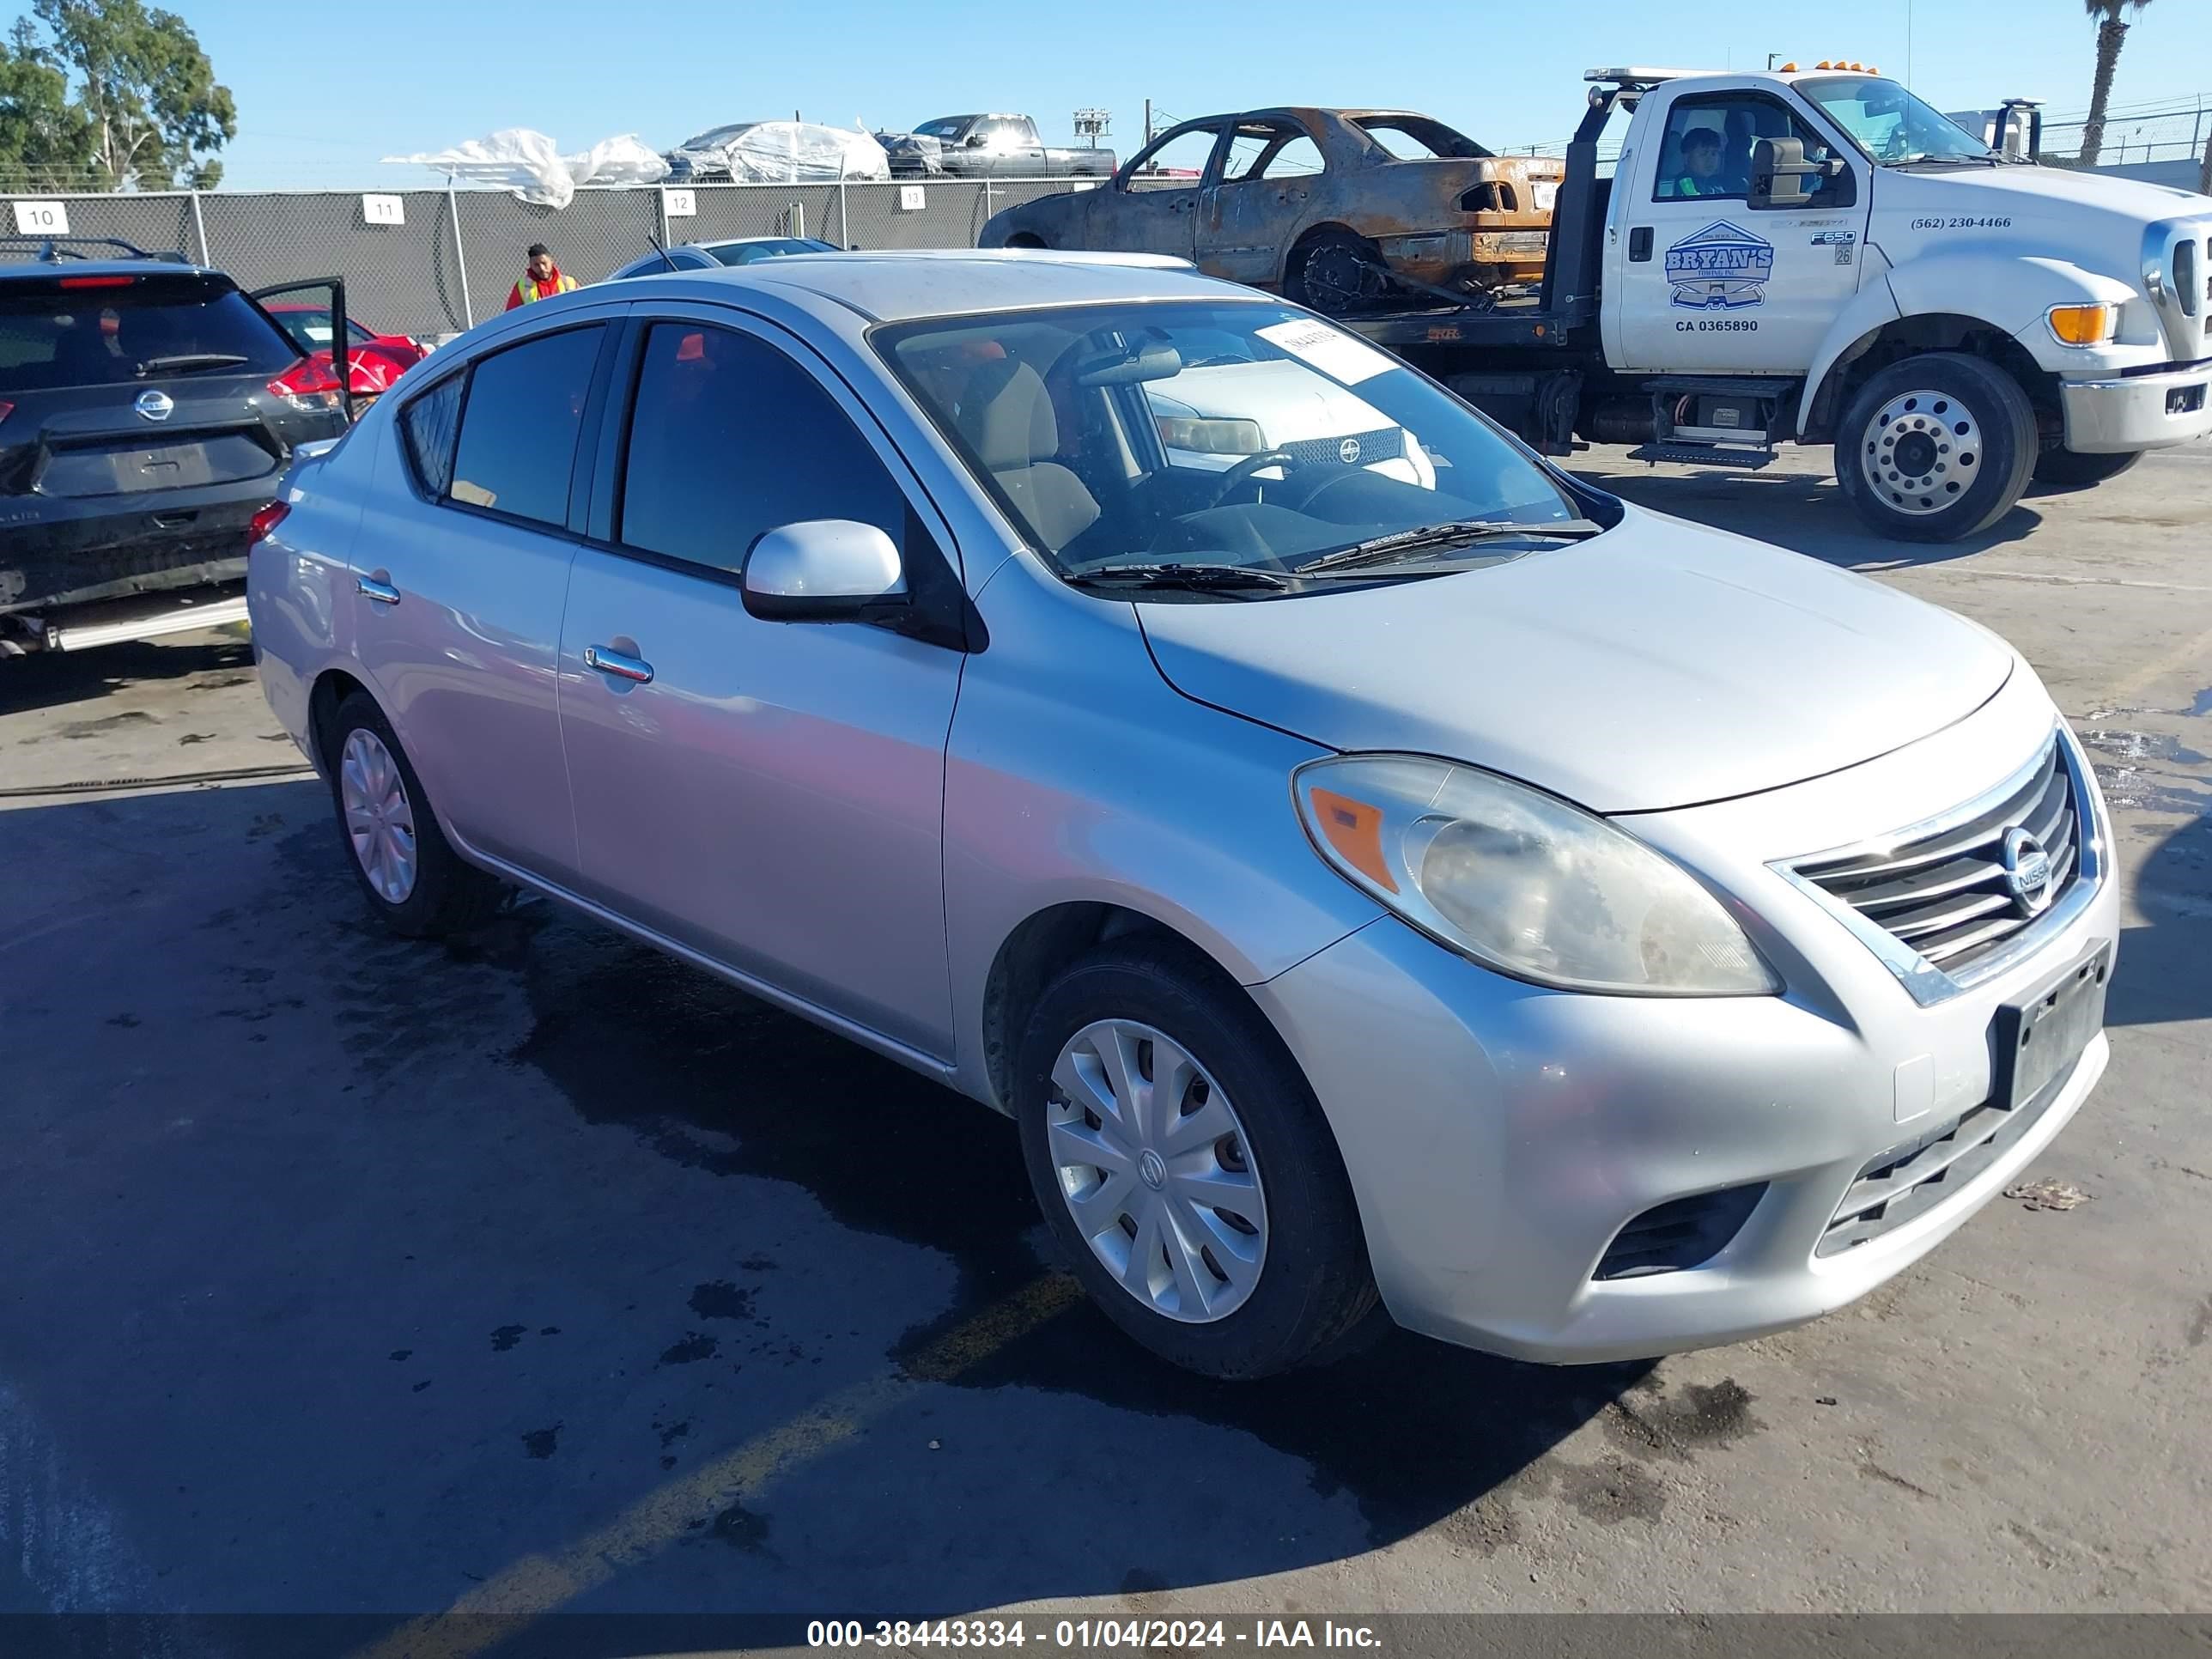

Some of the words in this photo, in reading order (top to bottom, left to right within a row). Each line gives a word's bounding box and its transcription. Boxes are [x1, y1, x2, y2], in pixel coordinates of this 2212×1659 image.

[673, 197, 688, 209] 12
[908, 192, 918, 204] 13
[376, 203, 392, 216] 11
[28, 210, 53, 226] 10
[1911, 218, 1946, 231] (562)
[1948, 216, 2013, 228] 230-4466
[1666, 246, 1774, 270] BRYAN'S
[1837, 250, 1851, 263] 26
[1675, 321, 1695, 332] CA
[1698, 320, 1759, 332] 0365890
[2018, 863, 2048, 888] NISS
